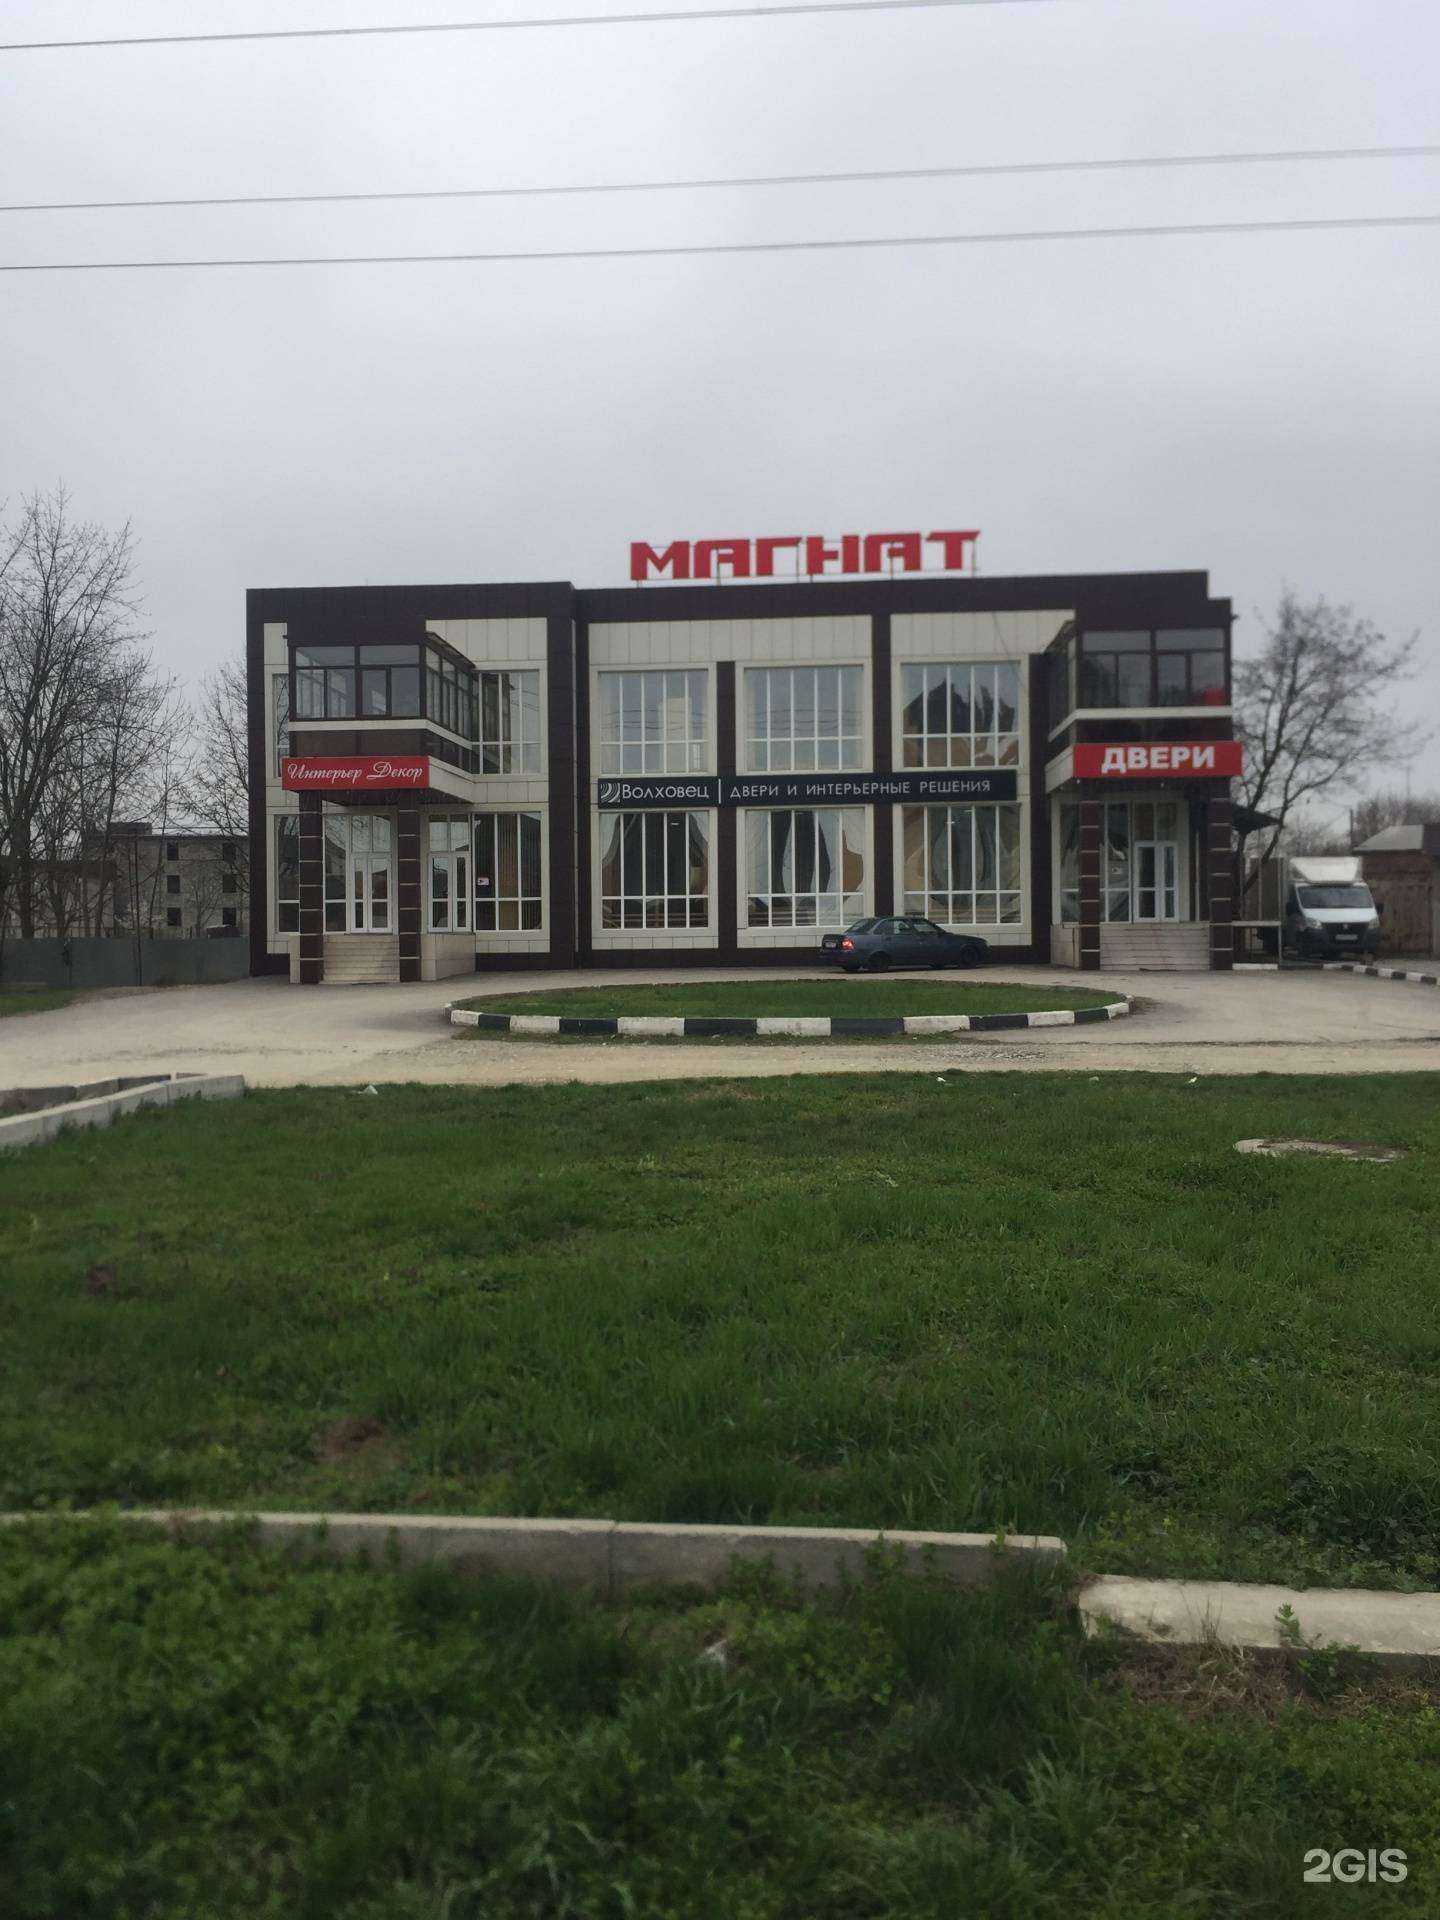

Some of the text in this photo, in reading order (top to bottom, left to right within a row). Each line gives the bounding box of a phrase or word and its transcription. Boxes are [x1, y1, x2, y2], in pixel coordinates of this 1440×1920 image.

[630, 530, 980, 581] МАГНАТ
[287, 761, 423, 784] Интерьер Декор
[1101, 746, 1215, 774] ДВЕРИ
[730, 784, 779, 798] ДВЕРИ
[787, 784, 798, 797] И
[806, 781, 911, 796] ИНТЕРЬЕРНЫЕ
[919, 779, 992, 794] РЕШЕНИЯ
